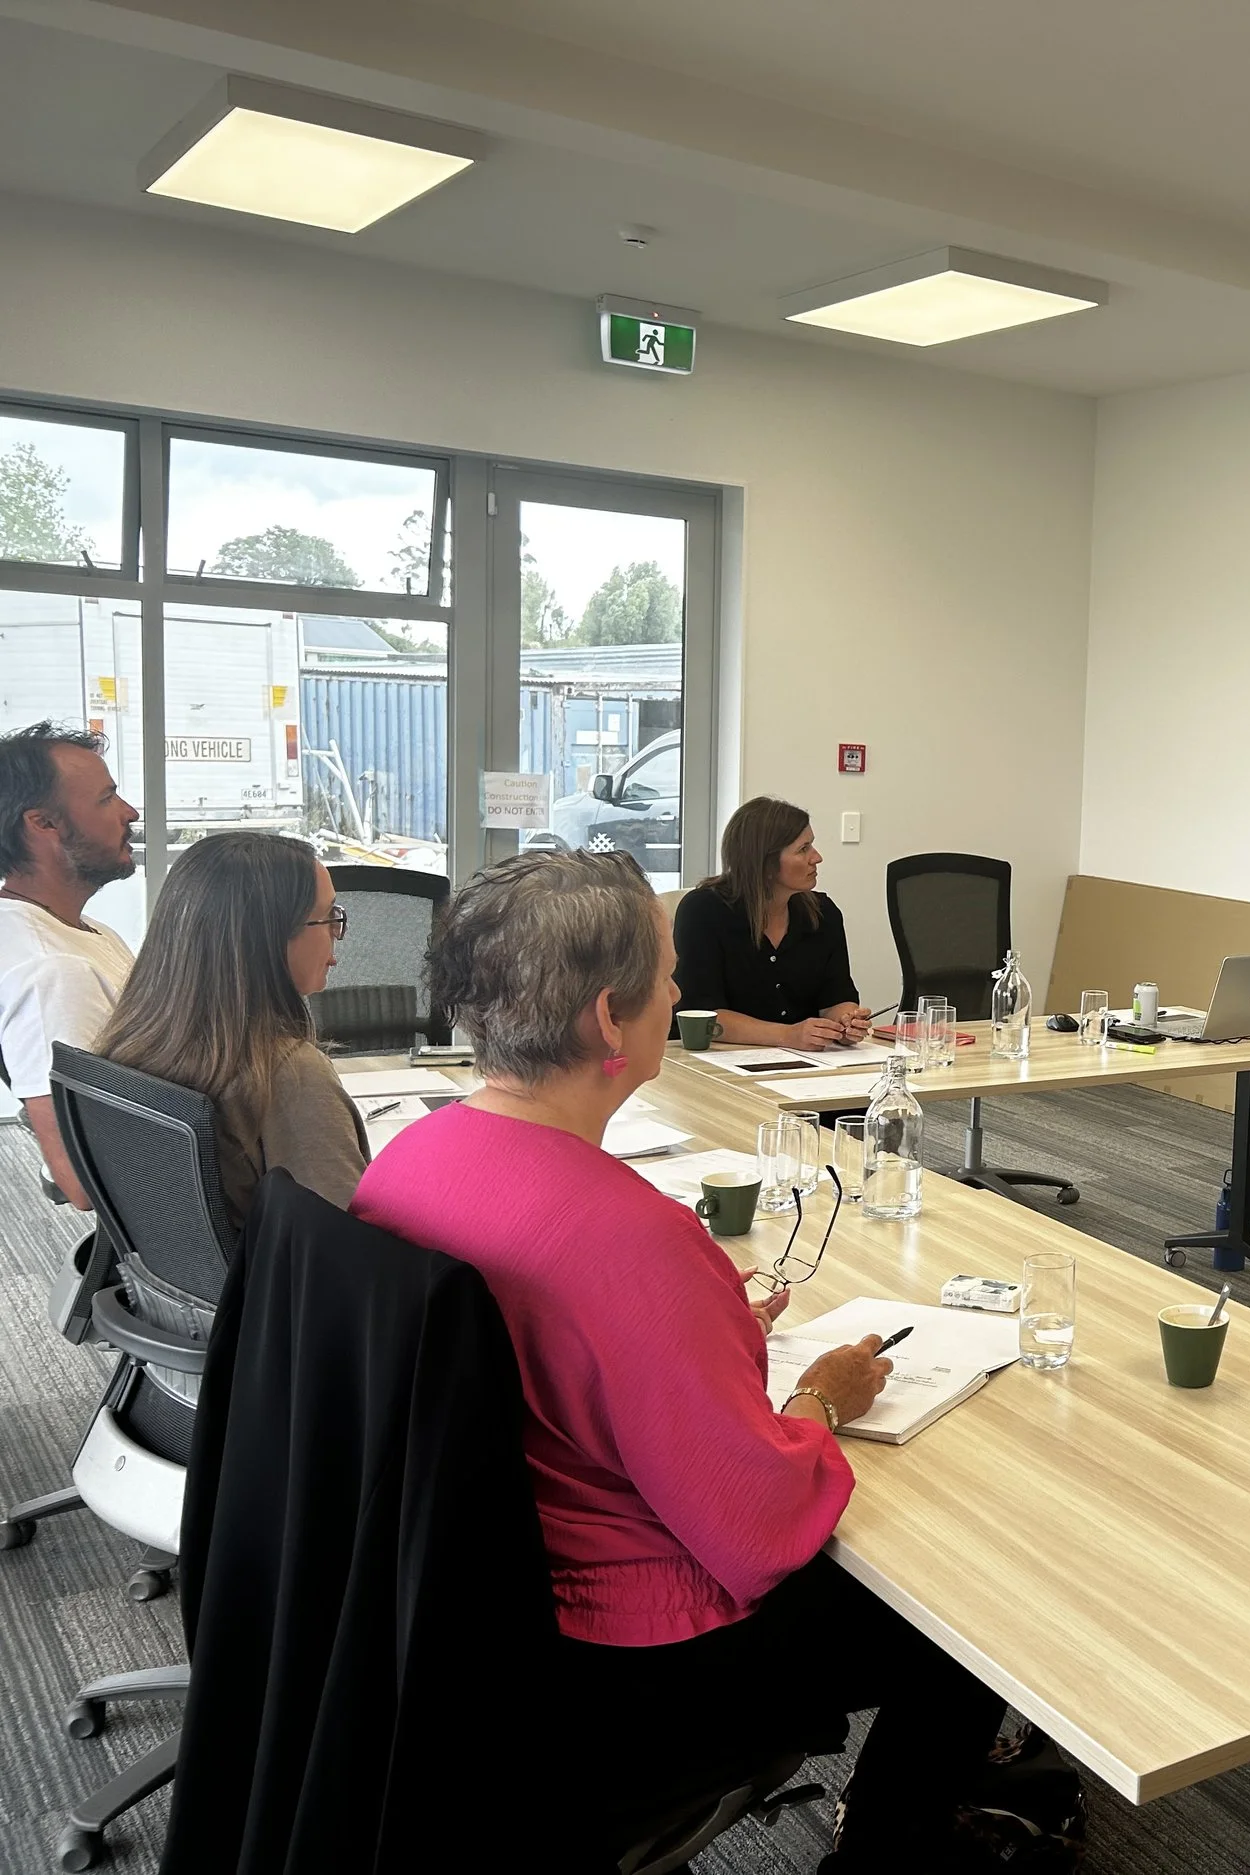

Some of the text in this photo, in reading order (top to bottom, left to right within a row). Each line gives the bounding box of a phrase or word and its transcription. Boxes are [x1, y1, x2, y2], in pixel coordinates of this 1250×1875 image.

[165, 740, 243, 759] ONG VEHICLE
[504, 779, 538, 789] Caution
[487, 806, 502, 815] DO
[504, 807, 523, 816] NOT
